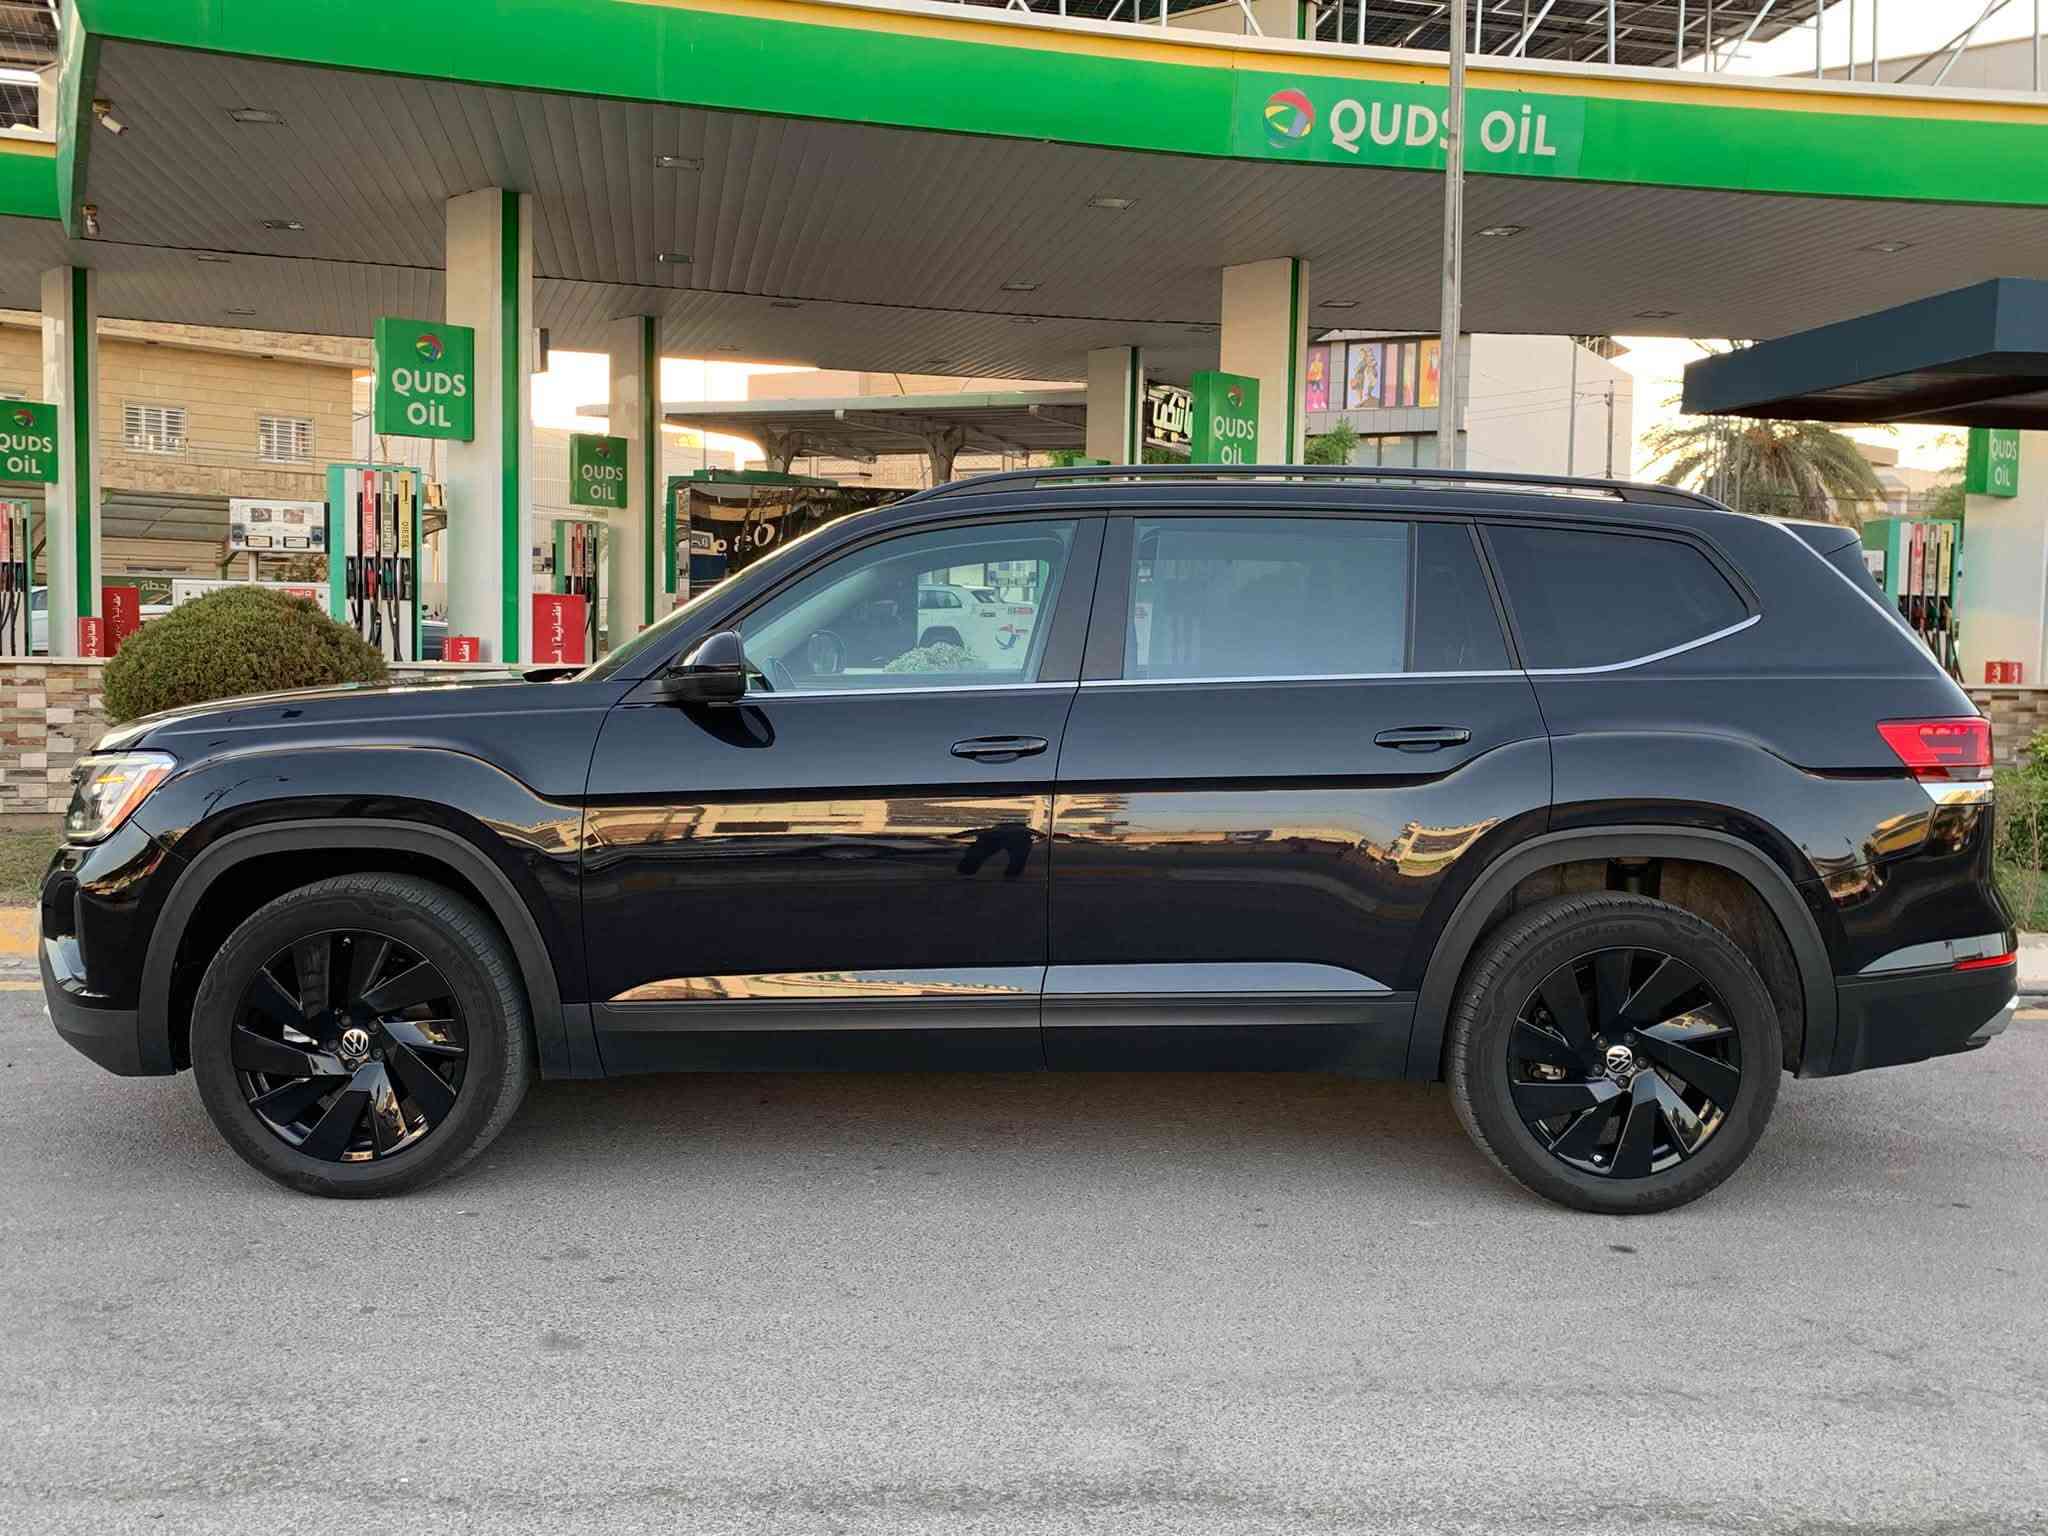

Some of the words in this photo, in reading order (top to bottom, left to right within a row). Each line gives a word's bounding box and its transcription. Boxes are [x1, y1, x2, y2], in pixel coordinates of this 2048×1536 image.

[391, 367, 467, 397] QUDS
[1213, 415, 1255, 441] QUDS
[0, 433, 53, 454] QUDS
[1991, 437, 2017, 461] QUDS
[581, 463, 624, 482] QUDS
